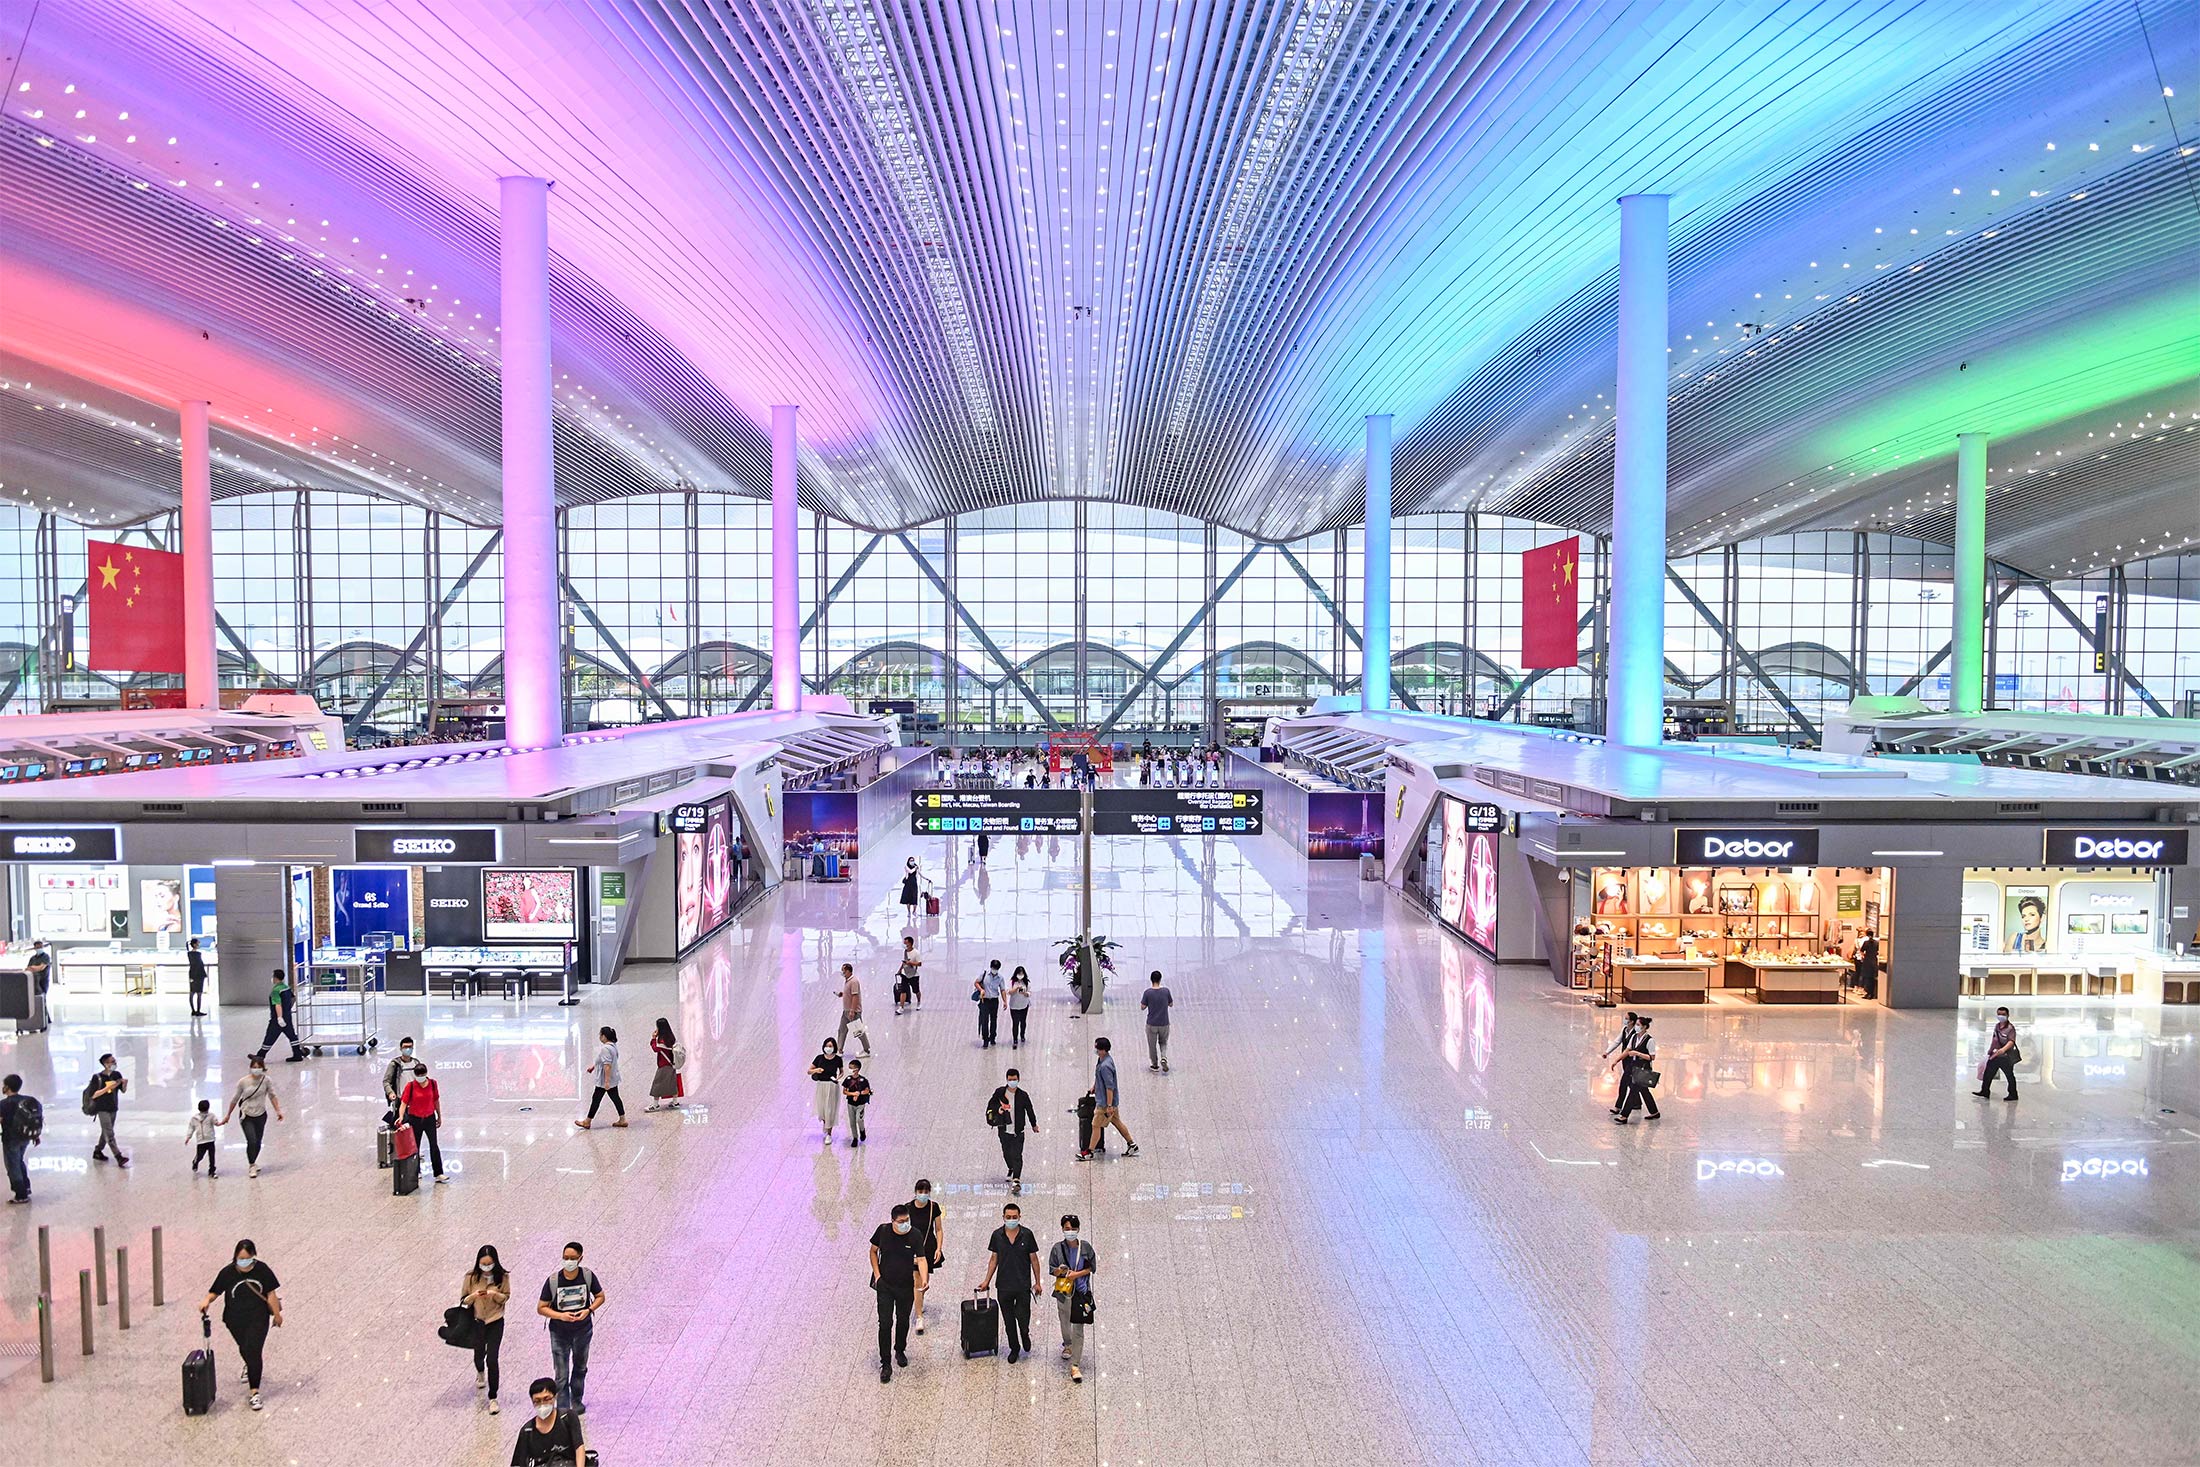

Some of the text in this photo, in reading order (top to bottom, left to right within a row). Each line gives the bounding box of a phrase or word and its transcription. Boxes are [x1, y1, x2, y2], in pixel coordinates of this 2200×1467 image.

[65, 651, 73, 669] J
[569, 655, 575, 670] H
[1594, 652, 1600, 668] F
[2095, 652, 2103, 670] E
[678, 806, 704, 817] G/19
[1131, 814, 1157, 822] 商务中心
[1469, 806, 1496, 817] G/18
[393, 838, 456, 854] SEIKO
[1703, 836, 1794, 859] Debor
[2075, 836, 2164, 859] Debor
[430, 898, 469, 908] SEIKO
[2090, 893, 2134, 907] Debor
